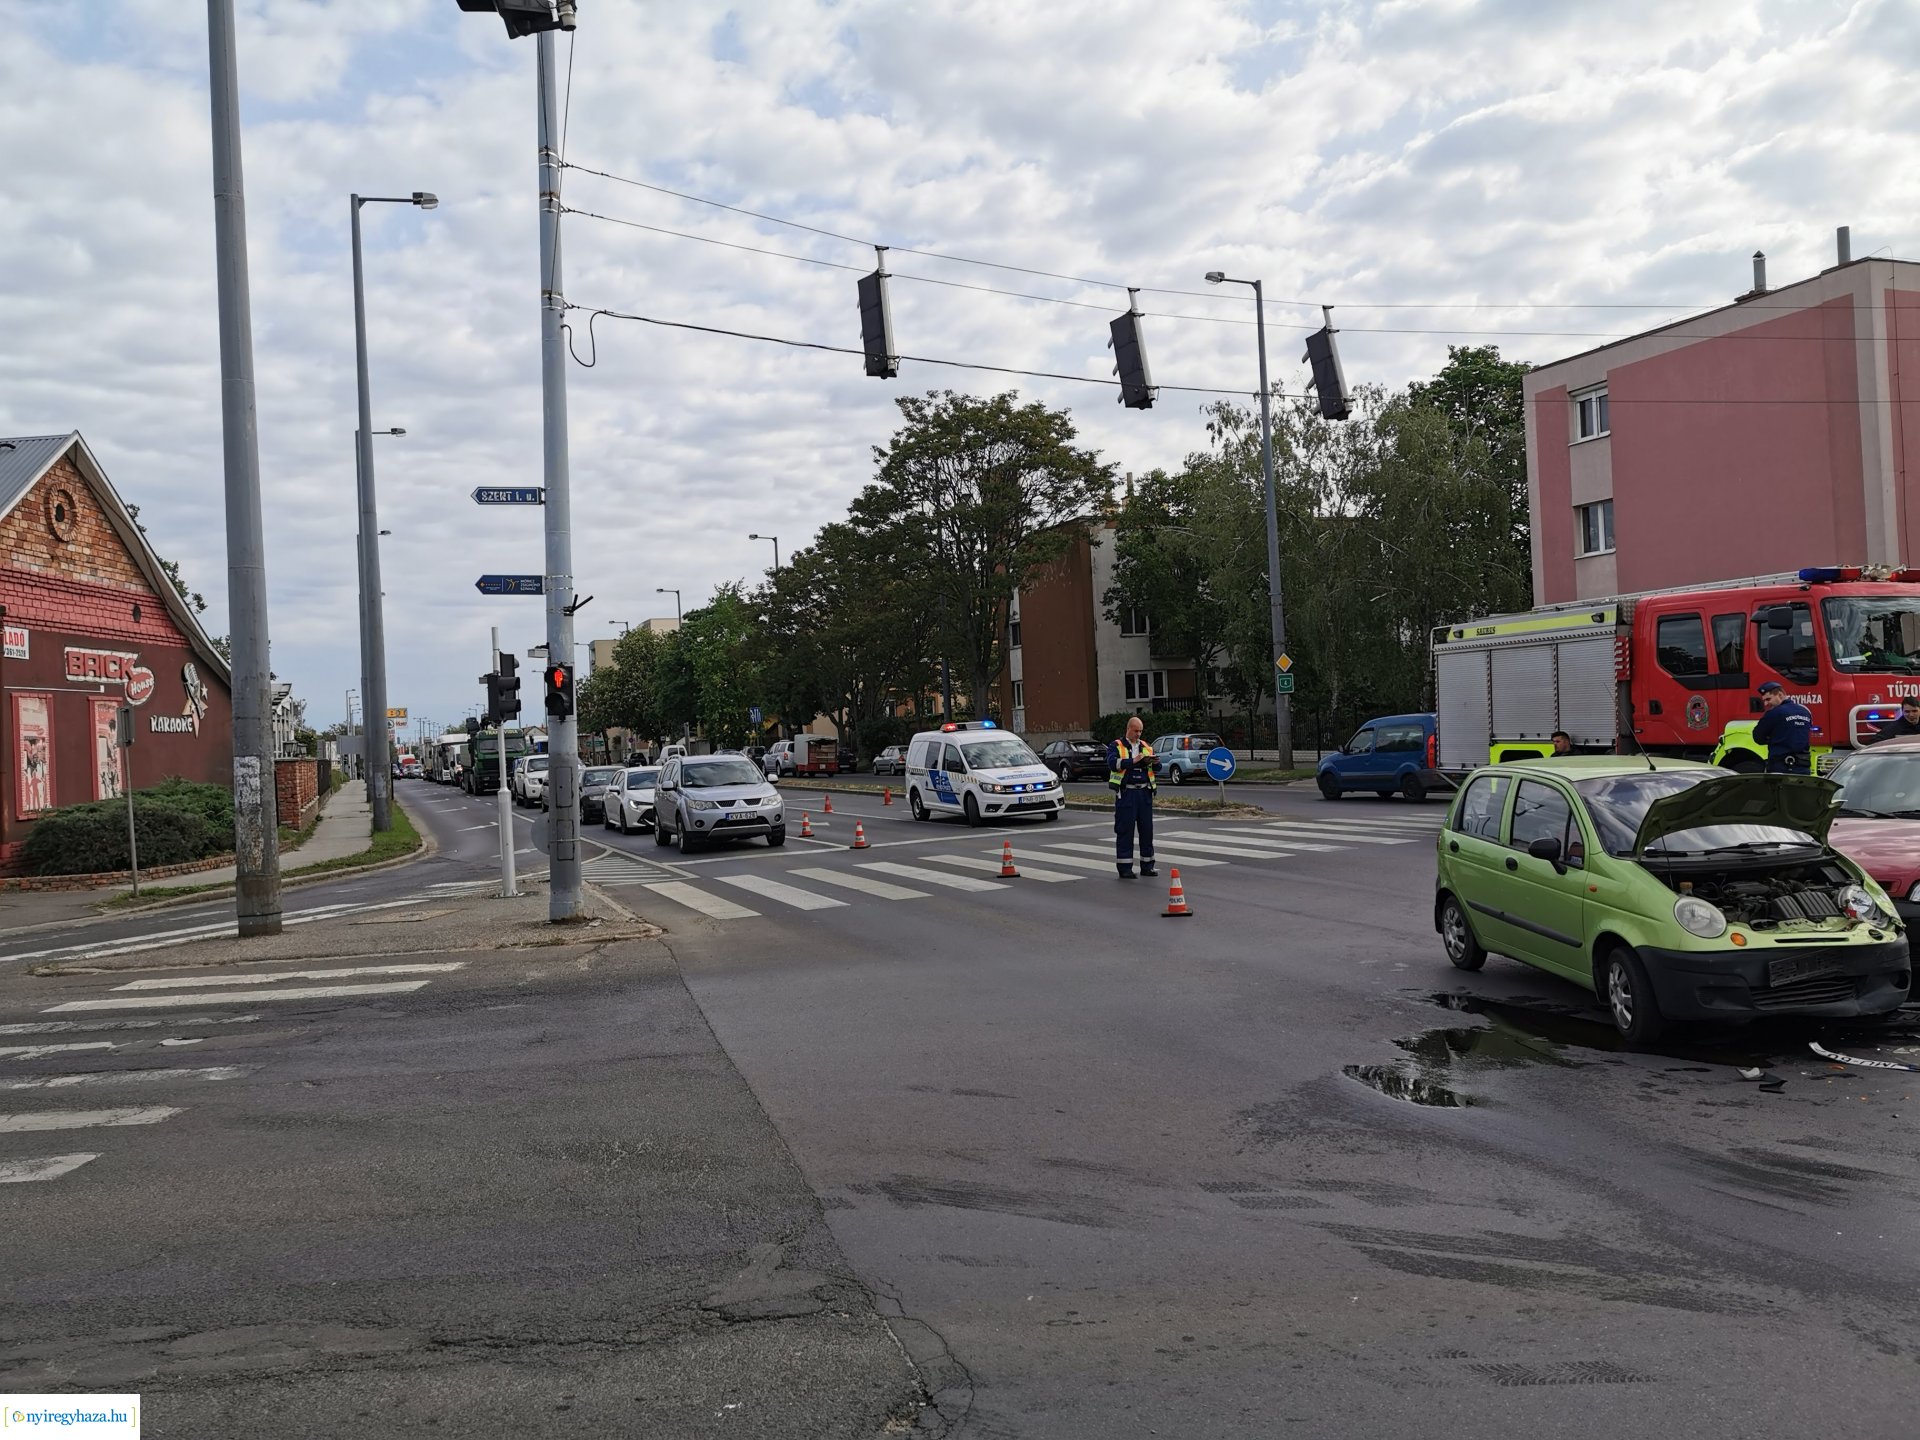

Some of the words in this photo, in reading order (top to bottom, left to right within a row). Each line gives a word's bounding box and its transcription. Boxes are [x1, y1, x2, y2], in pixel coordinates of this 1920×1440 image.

[481, 490, 512, 502] SZENT
[4, 631, 25, 648] LADÓ
[67, 650, 136, 681] BRICK
[1886, 680, 1920, 698] TŰZO
[1786, 692, 1823, 705] GYHÁZA
[150, 714, 194, 733] KARAOKE
